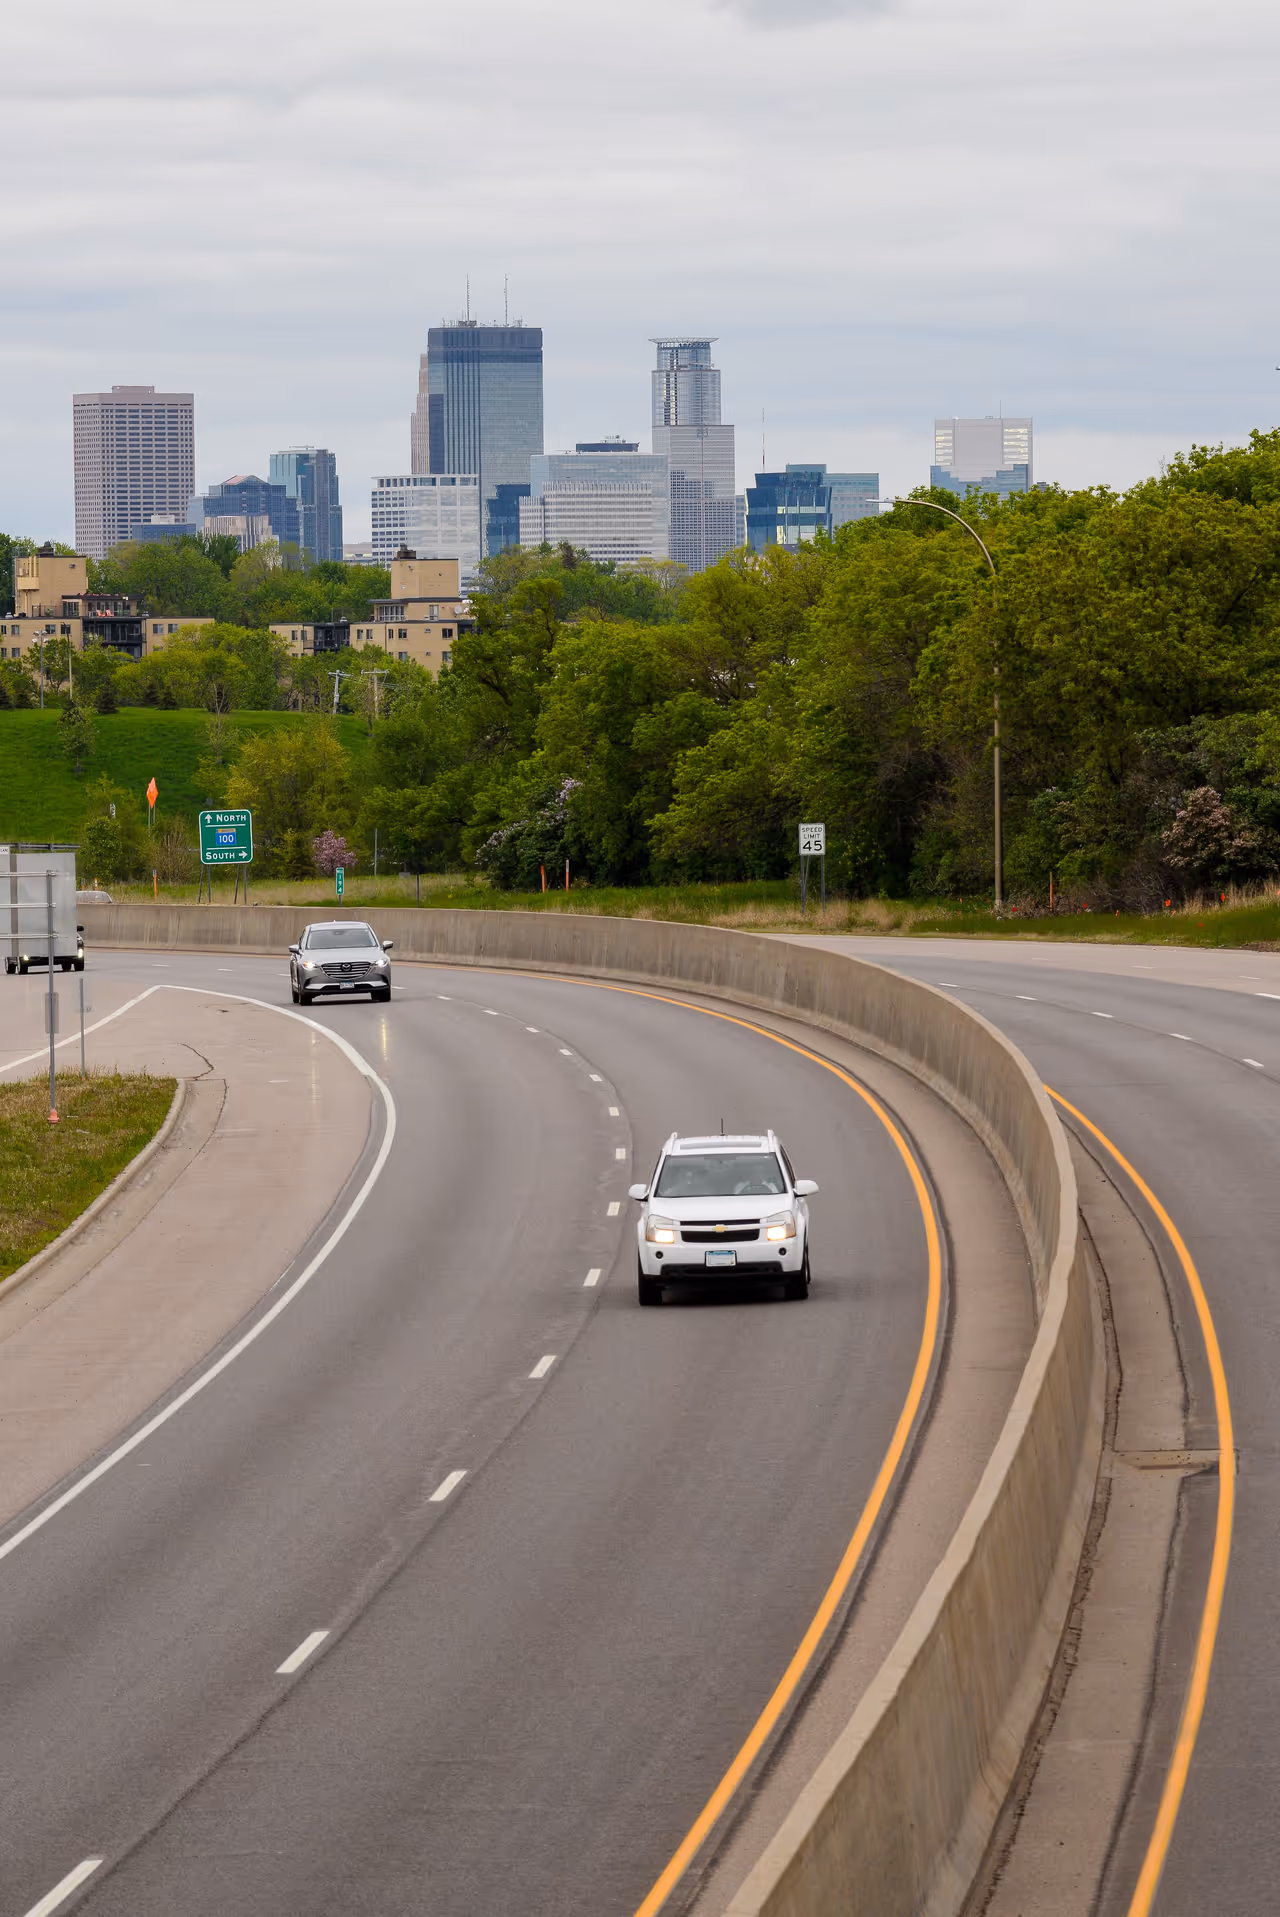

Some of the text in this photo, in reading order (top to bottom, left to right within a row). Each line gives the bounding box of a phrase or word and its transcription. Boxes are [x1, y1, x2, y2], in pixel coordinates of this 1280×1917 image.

[216, 814, 246, 822] NORTH
[219, 835, 234, 843] 100
[803, 841, 822, 851] 45
[206, 852, 235, 860] SOUTH
